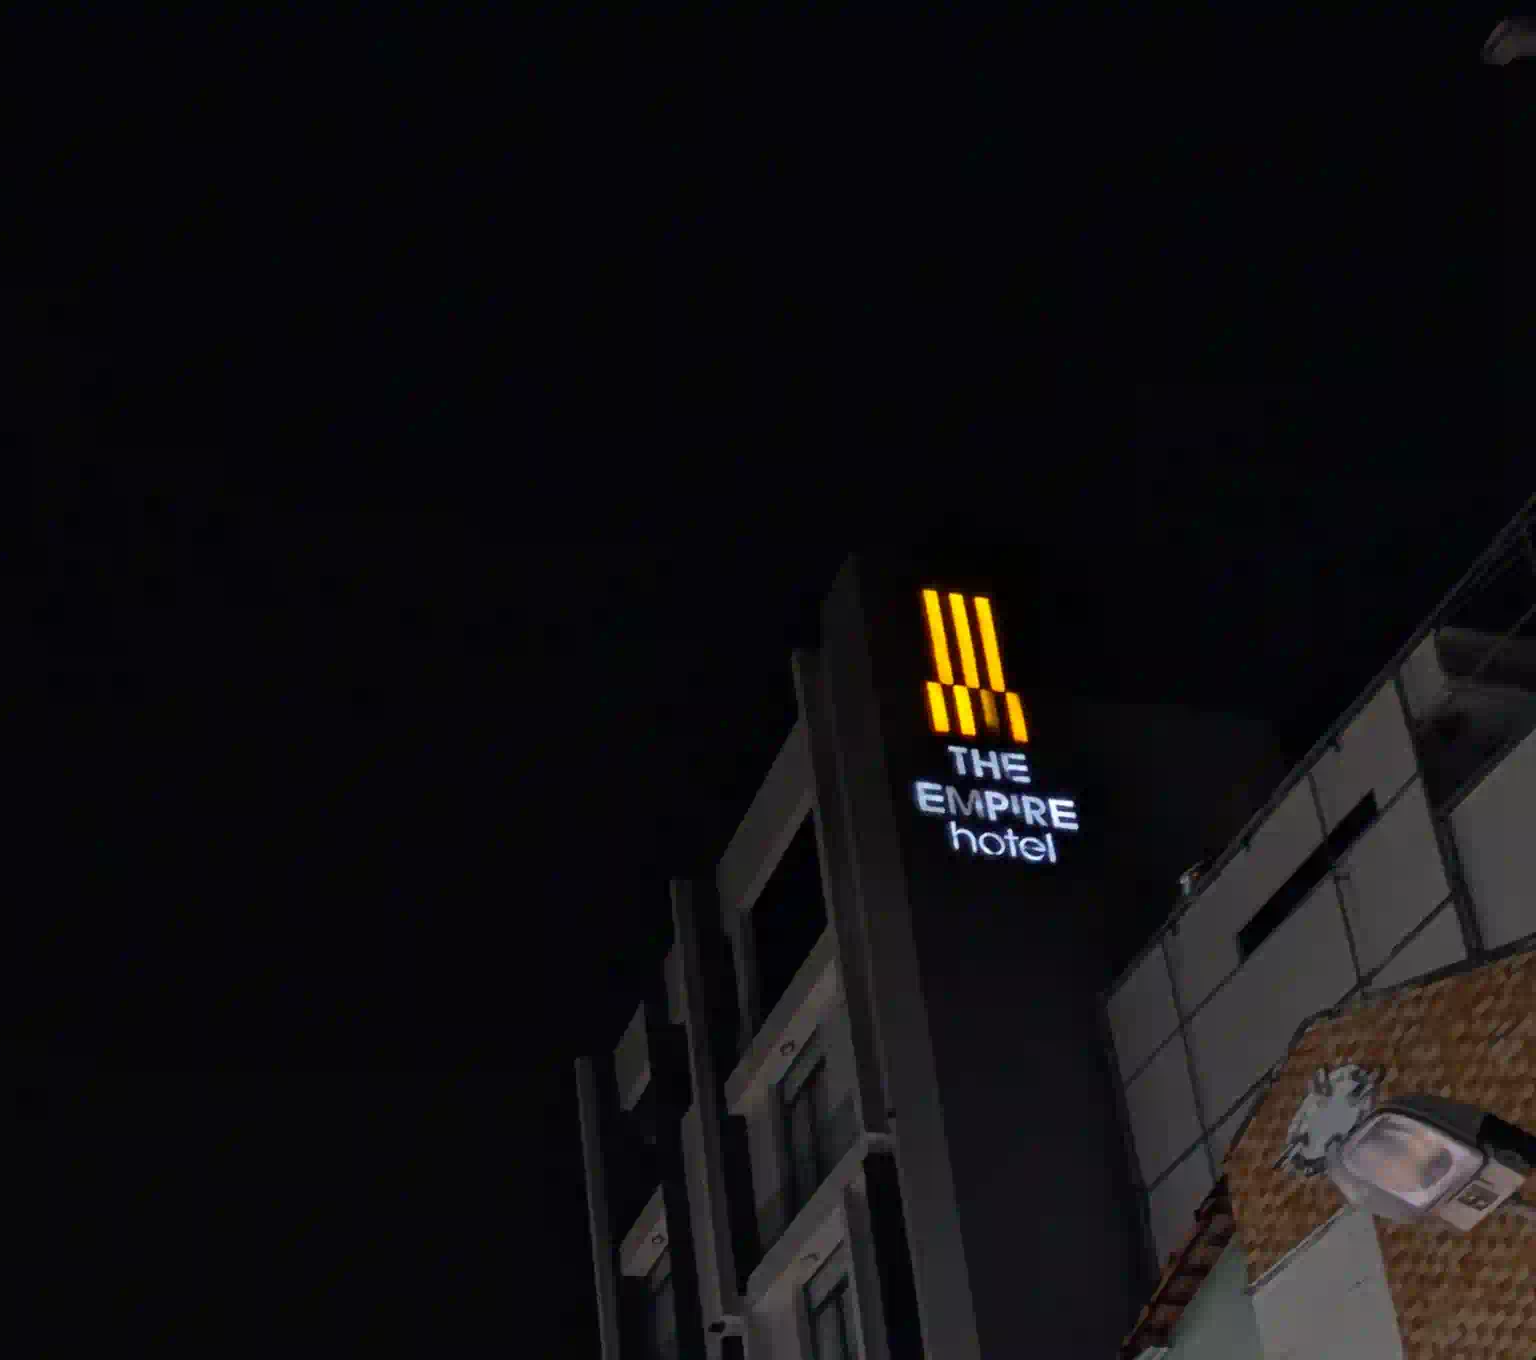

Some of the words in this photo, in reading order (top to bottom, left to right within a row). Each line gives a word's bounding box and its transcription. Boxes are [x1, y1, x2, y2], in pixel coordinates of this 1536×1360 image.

[947, 745, 1031, 783] THE
[915, 781, 1079, 830] EMPIRE
[949, 821, 1057, 863] hotel
